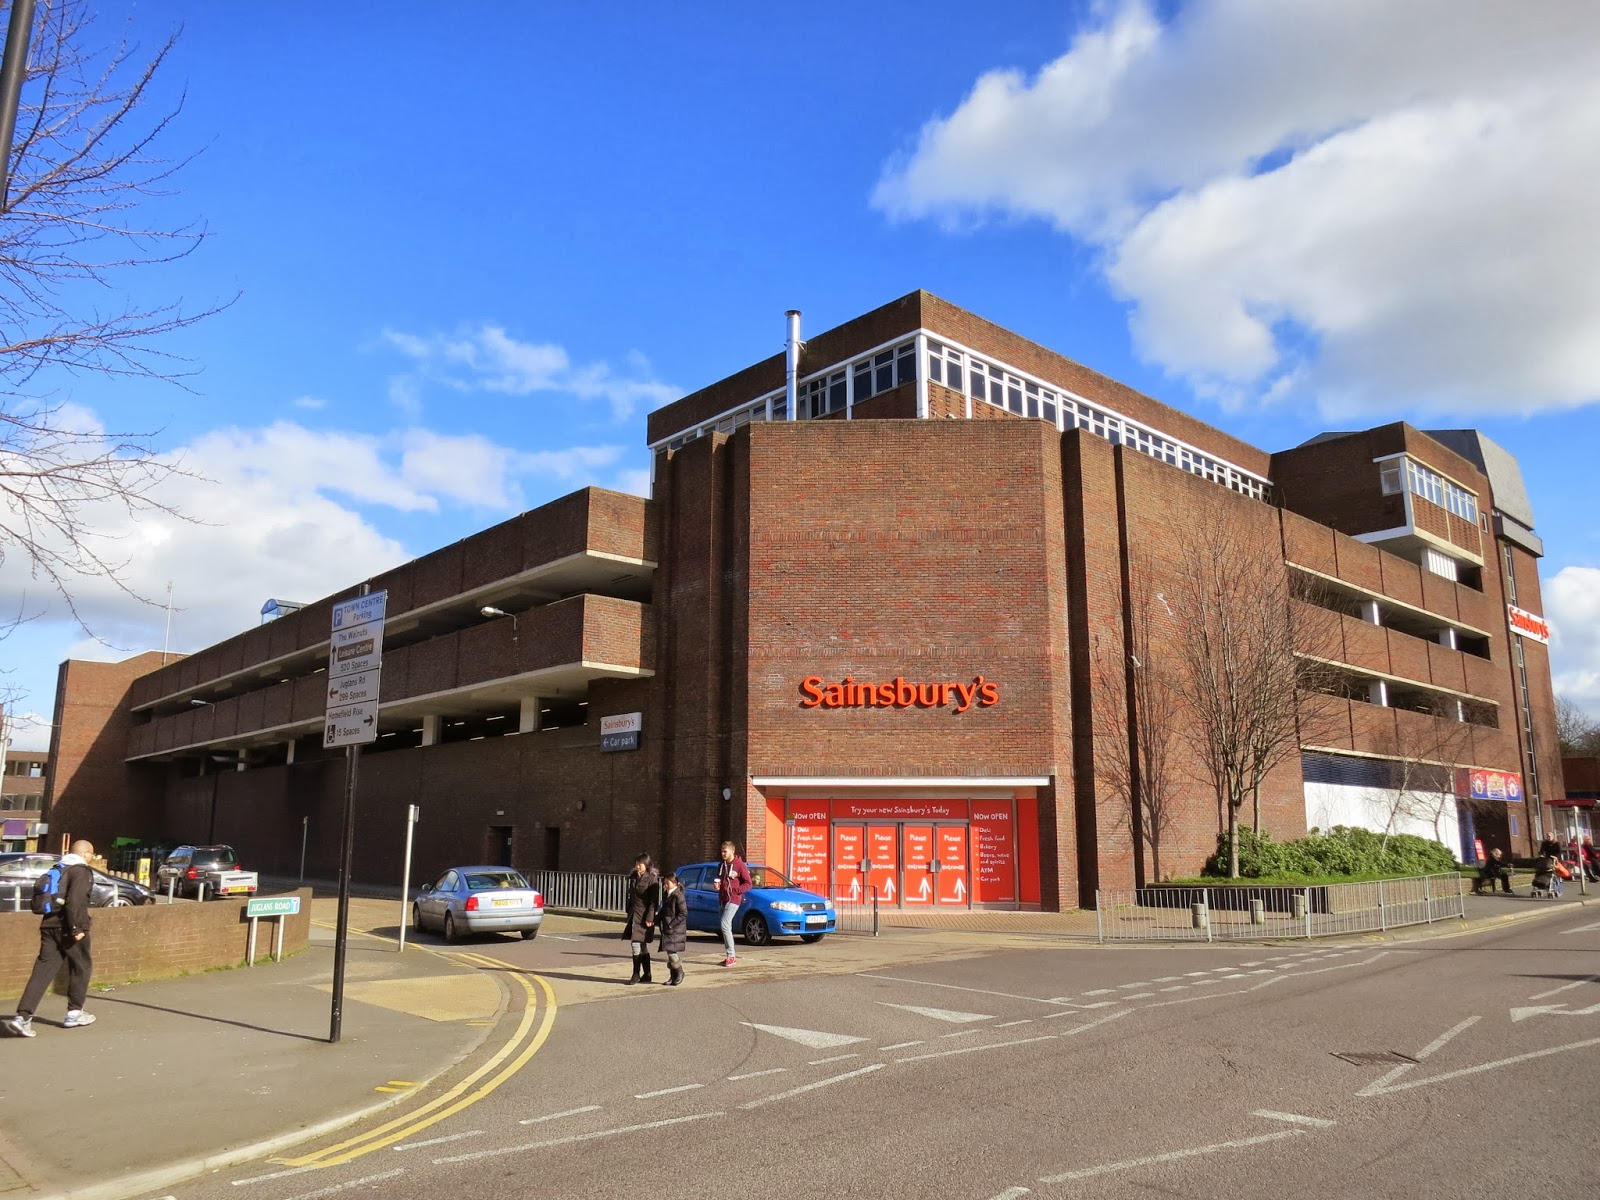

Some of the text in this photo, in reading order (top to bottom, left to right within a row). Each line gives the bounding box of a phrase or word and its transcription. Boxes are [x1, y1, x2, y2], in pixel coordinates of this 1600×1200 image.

[344, 596, 383, 613] TOWN CENTRE
[353, 611, 372, 621] Parking
[339, 629, 368, 642] The Walnuts
[356, 644, 373, 655] Centre
[351, 660, 369, 670] Spaces
[340, 676, 366, 690] Juglans Rd
[339, 690, 367, 701] 299 Spaces
[803, 675, 999, 712] Sainsbury's
[353, 707, 363, 716] Rise
[604, 717, 635, 729] Sainsbury's
[343, 727, 360, 737] Spaces
[610, 736, 635, 747] Car park
[851, 806, 862, 815] Try
[863, 807, 877, 815] your
[894, 805, 931, 815] Sainsbury's
[932, 805, 950, 815] Today
[251, 902, 290, 911] JUGLANS ROAD
